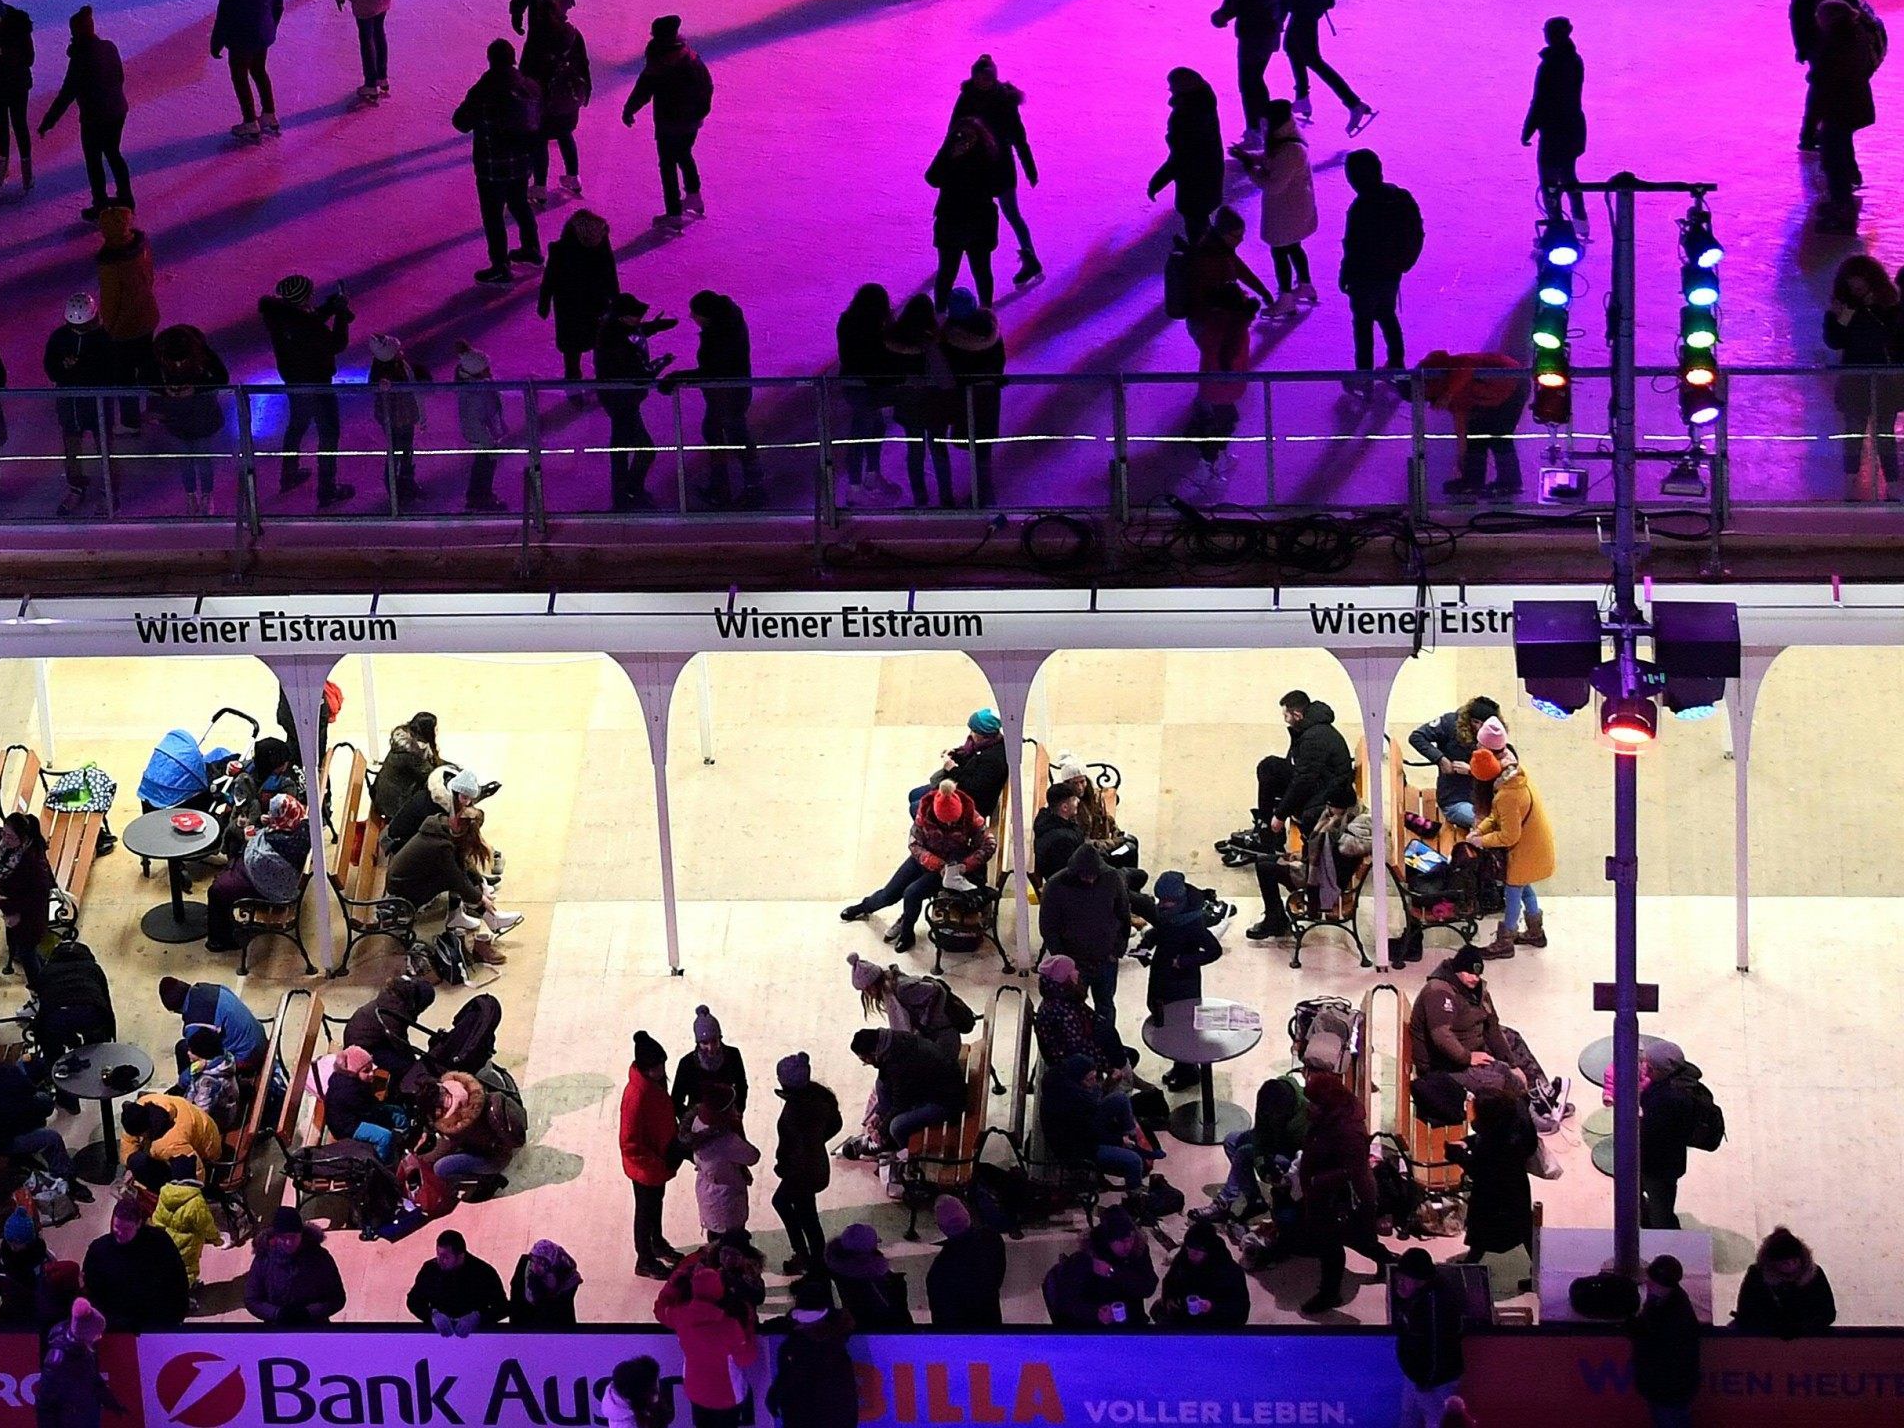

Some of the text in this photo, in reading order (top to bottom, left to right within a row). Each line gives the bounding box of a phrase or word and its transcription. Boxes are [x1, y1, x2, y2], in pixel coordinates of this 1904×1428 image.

[135, 611, 397, 643] Wiener Eistraum
[714, 606, 983, 638] Wiener Eistraum
[1309, 602, 1430, 634] Wiener
[257, 1357, 465, 1425] Bank
[854, 1363, 1354, 1425] BILLA VOLLER LEBEN.
